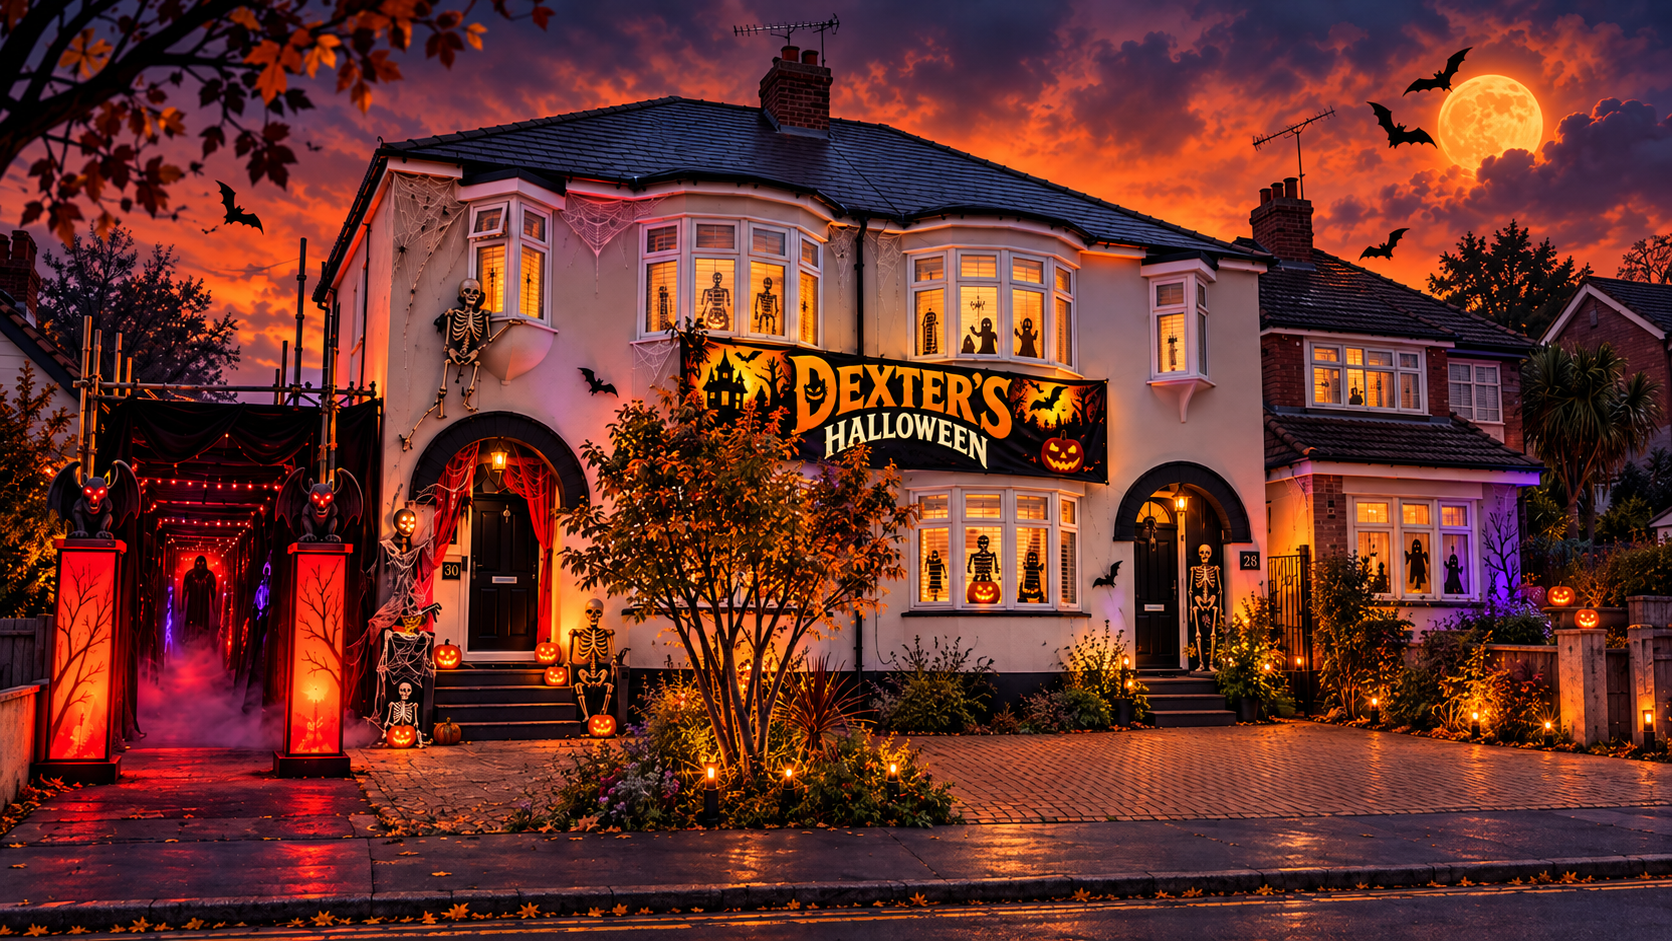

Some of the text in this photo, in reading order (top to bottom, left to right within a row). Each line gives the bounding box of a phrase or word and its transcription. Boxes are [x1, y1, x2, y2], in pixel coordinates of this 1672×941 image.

[789, 355, 1013, 439] DEXTER'S
[824, 412, 988, 469] HALLOWEEN
[444, 564, 459, 576] 30
[1243, 555, 1257, 567] 28
